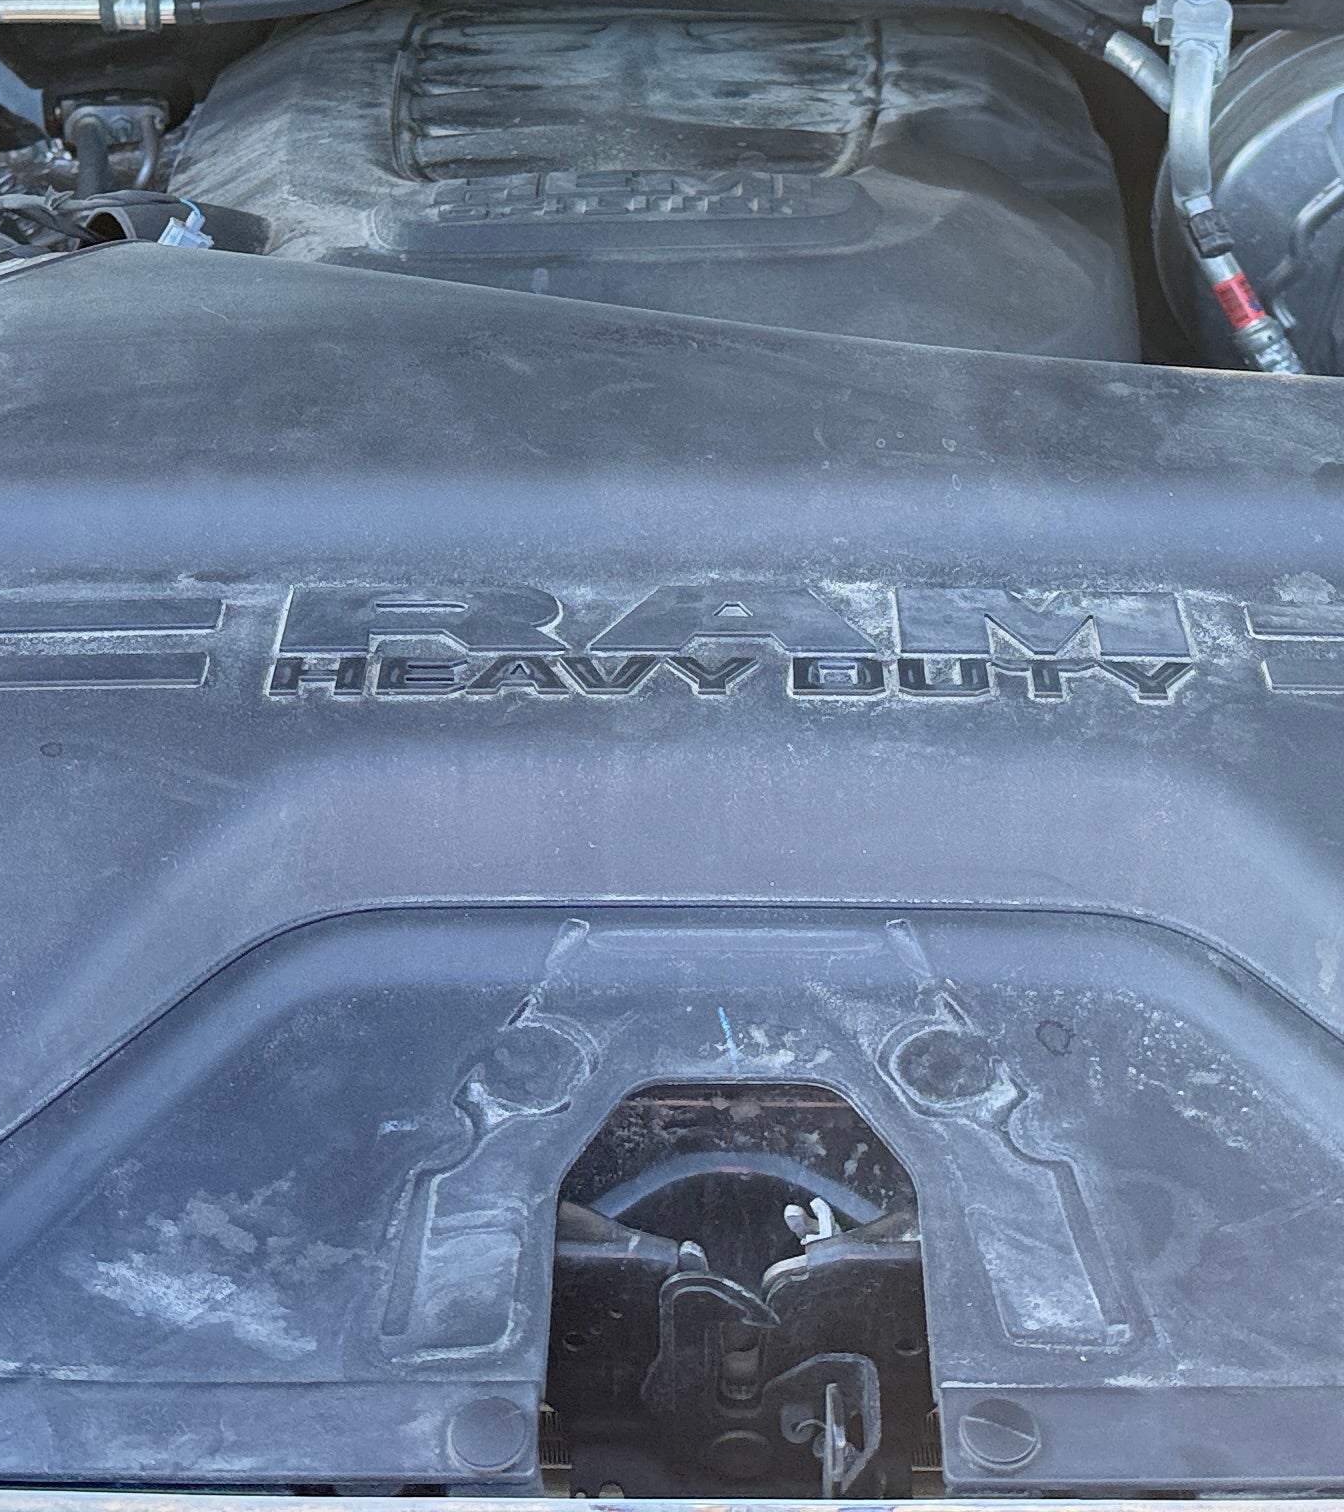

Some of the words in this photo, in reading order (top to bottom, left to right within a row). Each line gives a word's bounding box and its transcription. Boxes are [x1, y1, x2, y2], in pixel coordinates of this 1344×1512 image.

[278, 583, 1196, 658] RAM
[267, 656, 760, 699] HEAVY
[787, 656, 1194, 705] DUTY
